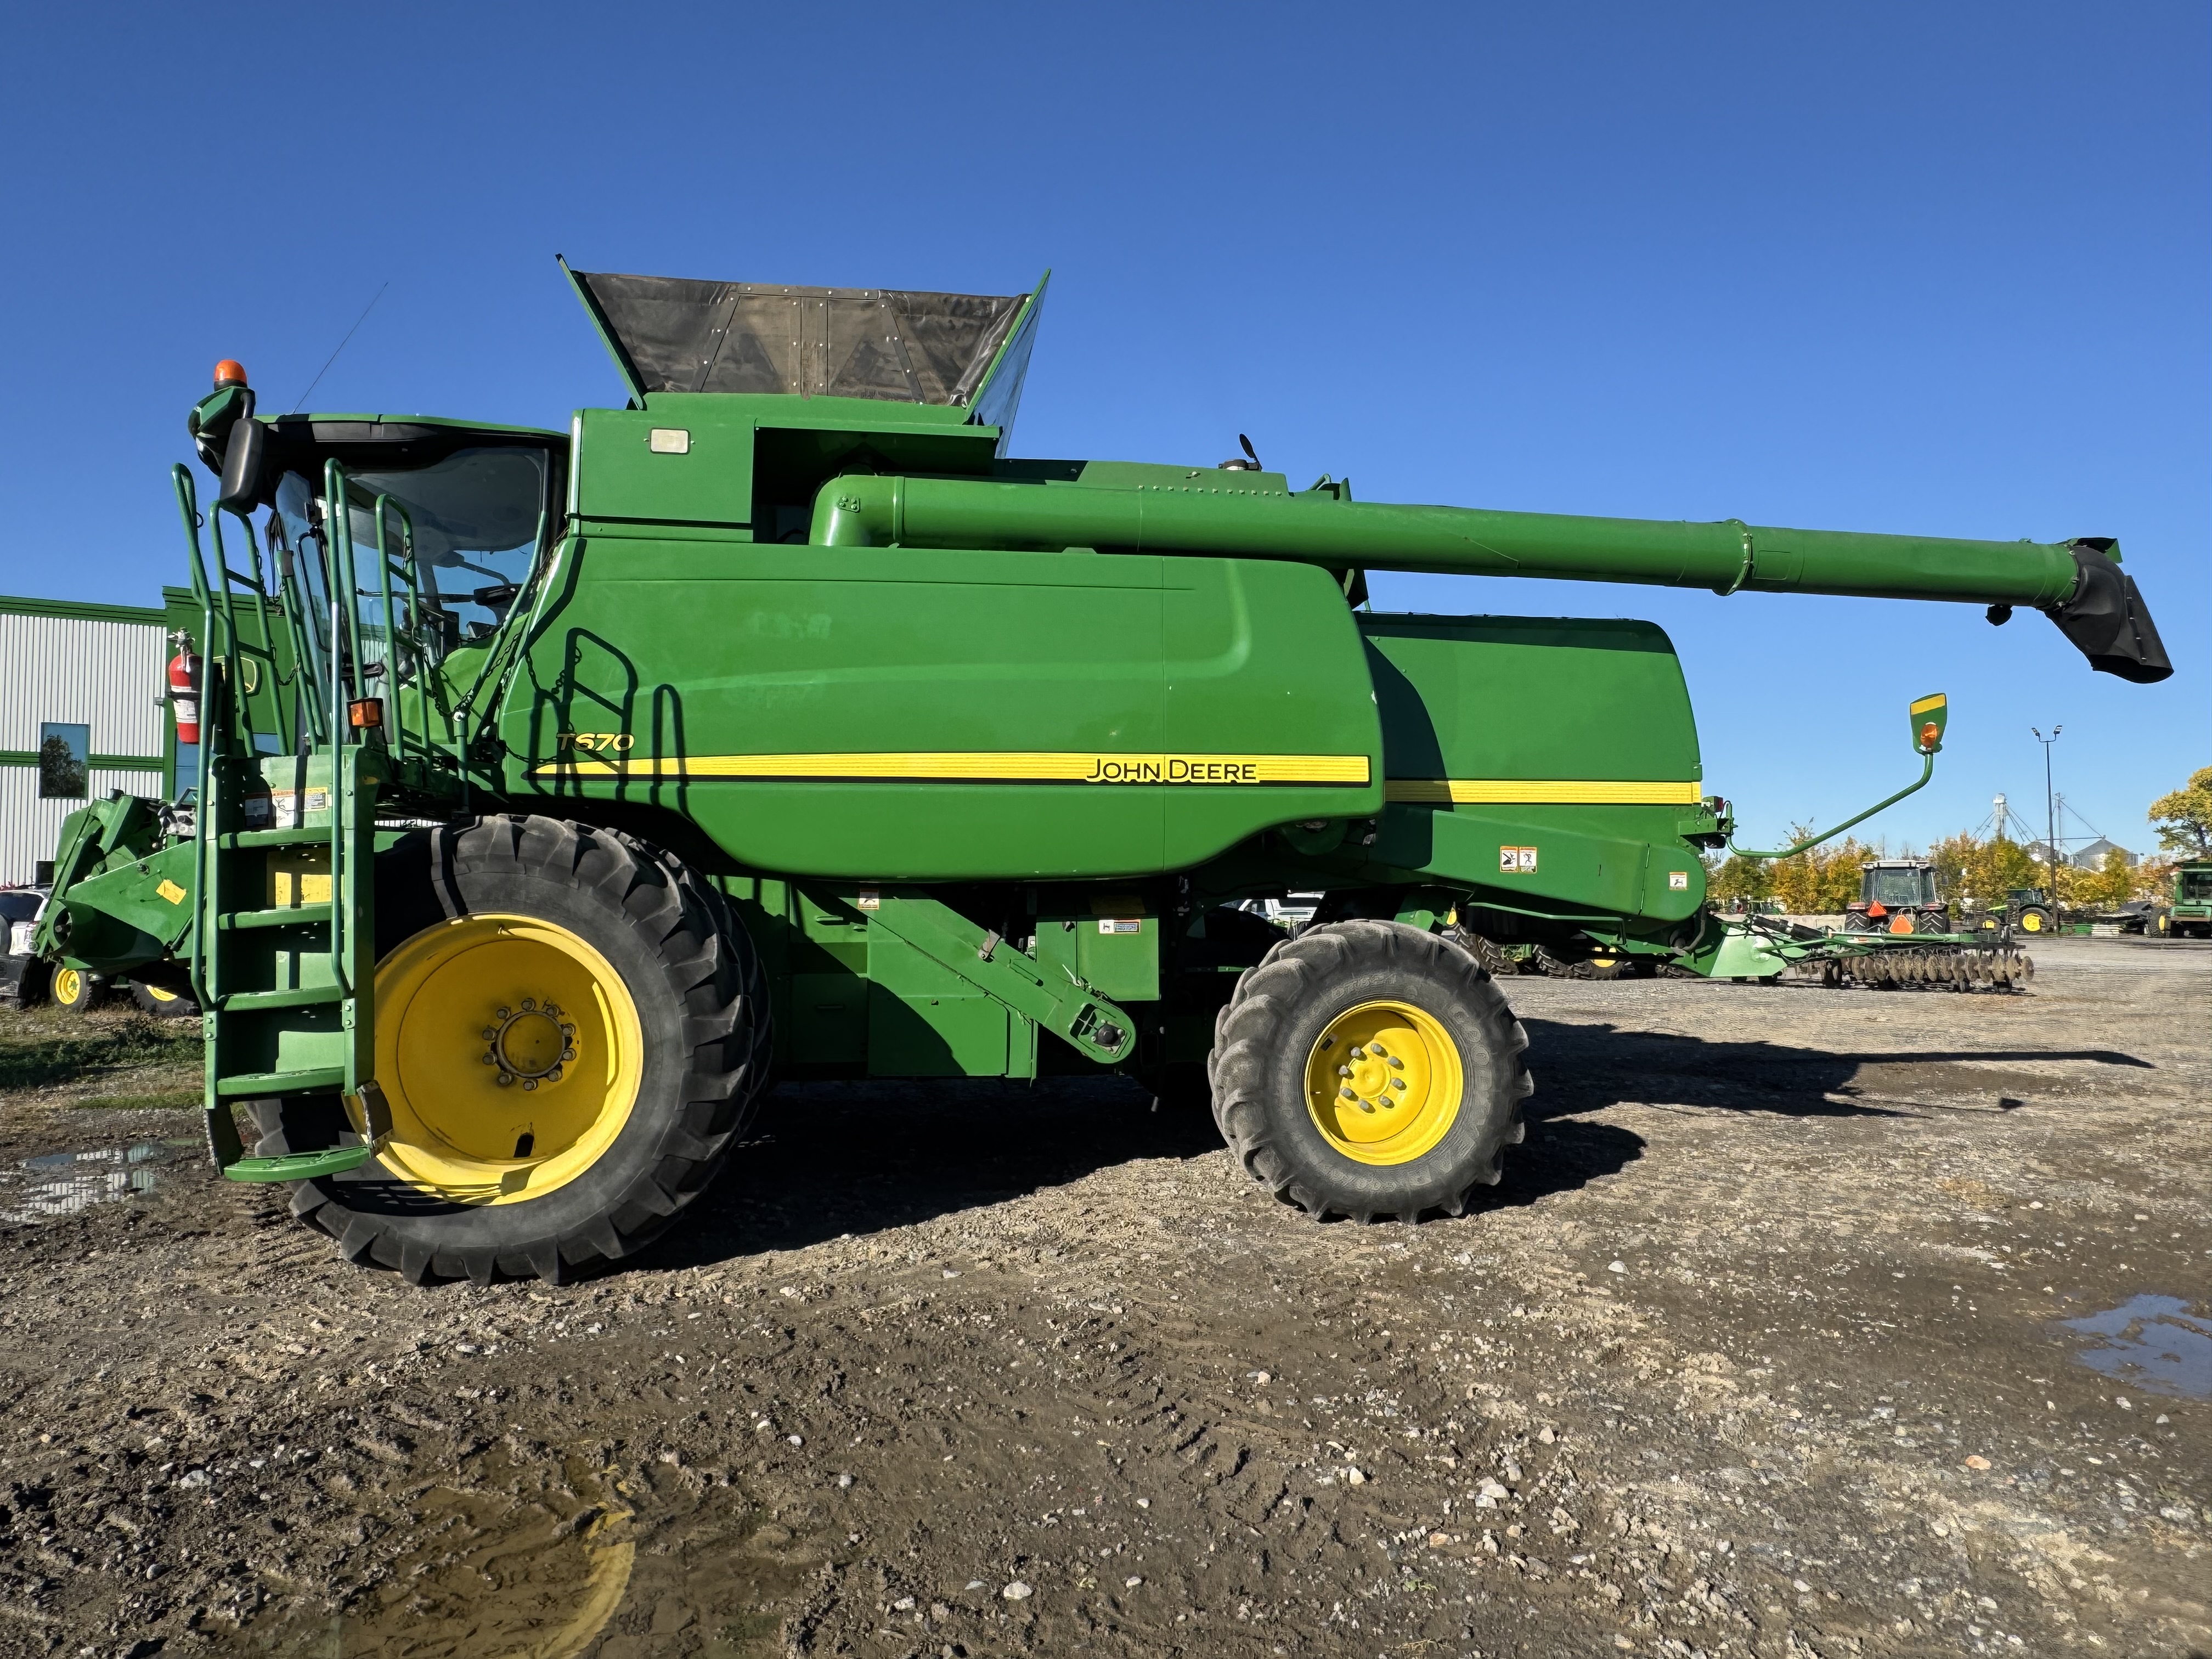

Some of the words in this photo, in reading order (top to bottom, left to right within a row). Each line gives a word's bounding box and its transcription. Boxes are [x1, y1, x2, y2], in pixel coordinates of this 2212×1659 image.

[557, 733, 635, 752] T670
[1087, 759, 1160, 779] JOHN
[1169, 759, 1257, 780] DEERE
